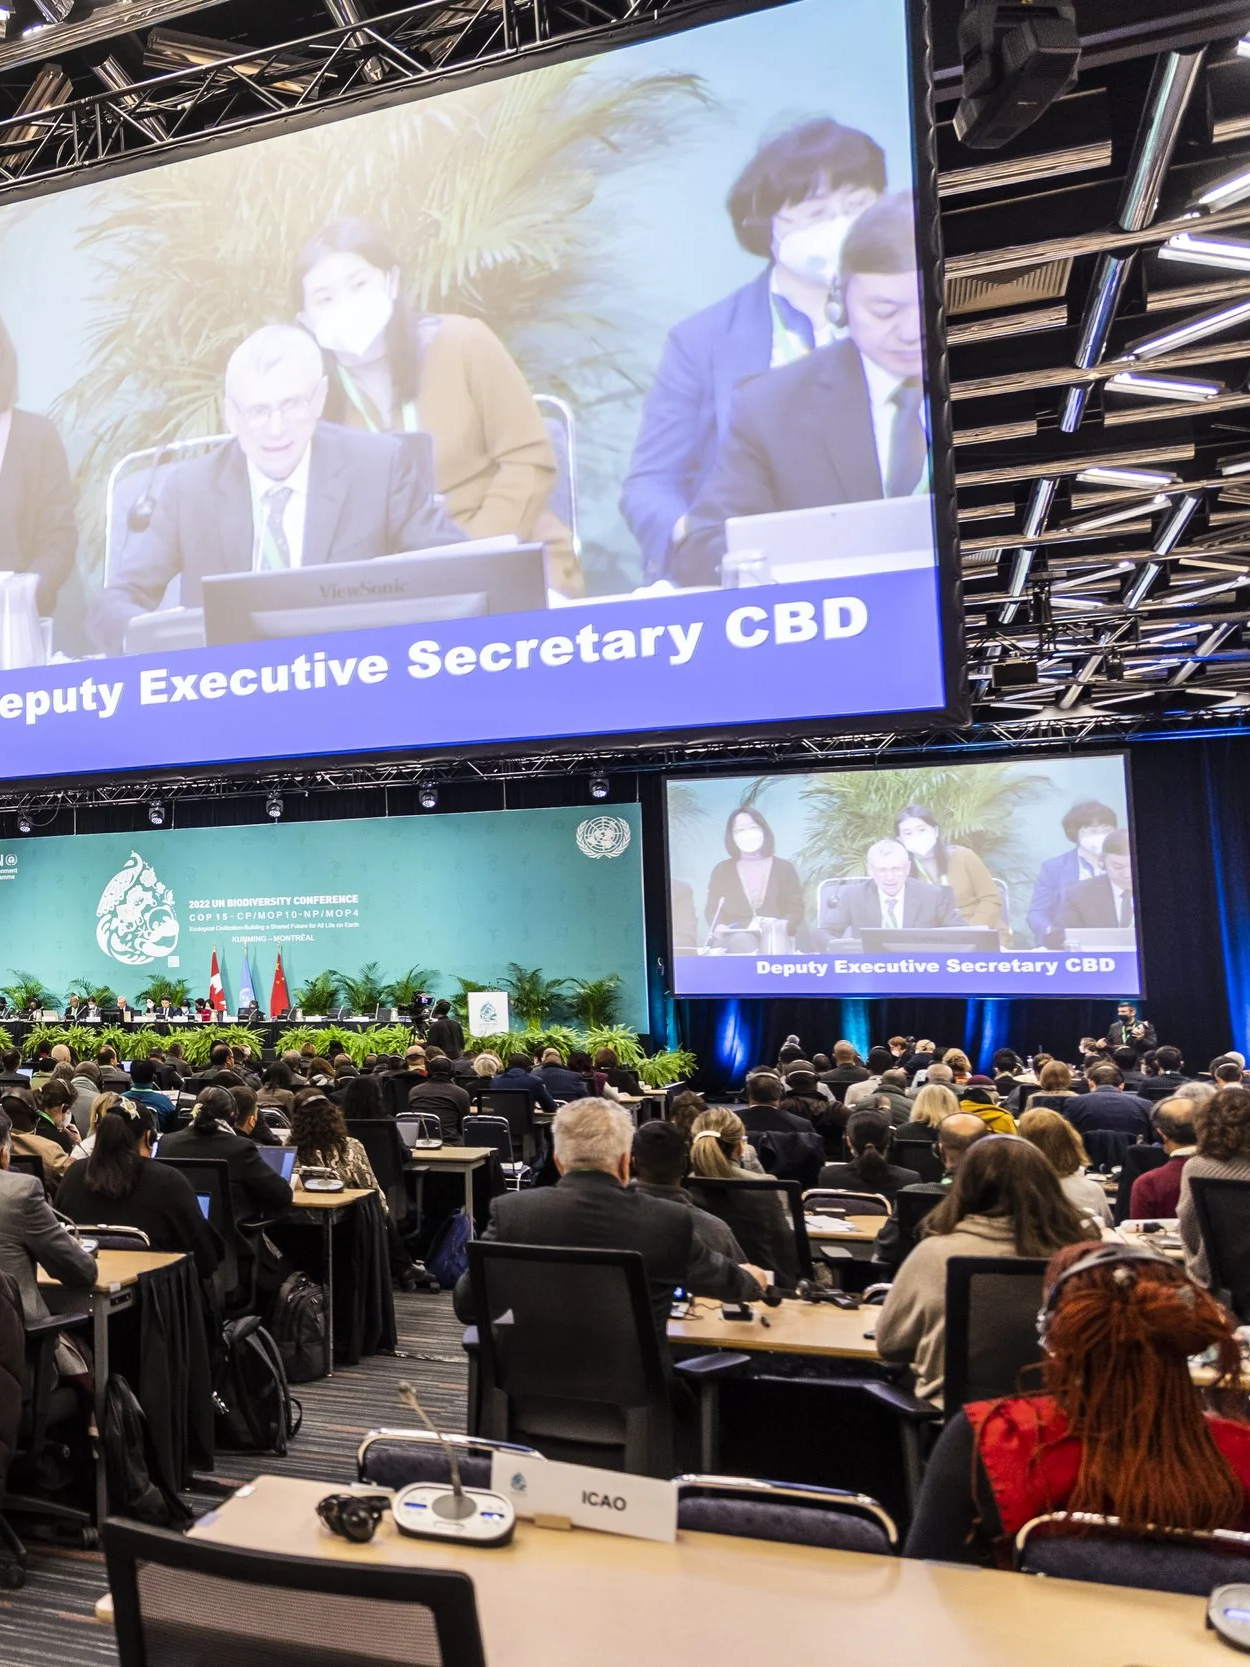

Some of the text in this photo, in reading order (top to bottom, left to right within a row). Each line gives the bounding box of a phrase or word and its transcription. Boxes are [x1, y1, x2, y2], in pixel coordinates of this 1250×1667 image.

[139, 652, 389, 705] Executive
[407, 621, 704, 680] Secretary
[725, 596, 869, 650] CBD
[189, 895, 358, 909] 2022 UN BIODIVERSITY CONFERENCE
[189, 913, 212, 921] COP
[232, 935, 267, 943] KUNMING
[756, 957, 1116, 977] Deputy Executive Secretary CBD
[581, 1489, 627, 1511] ICAO
